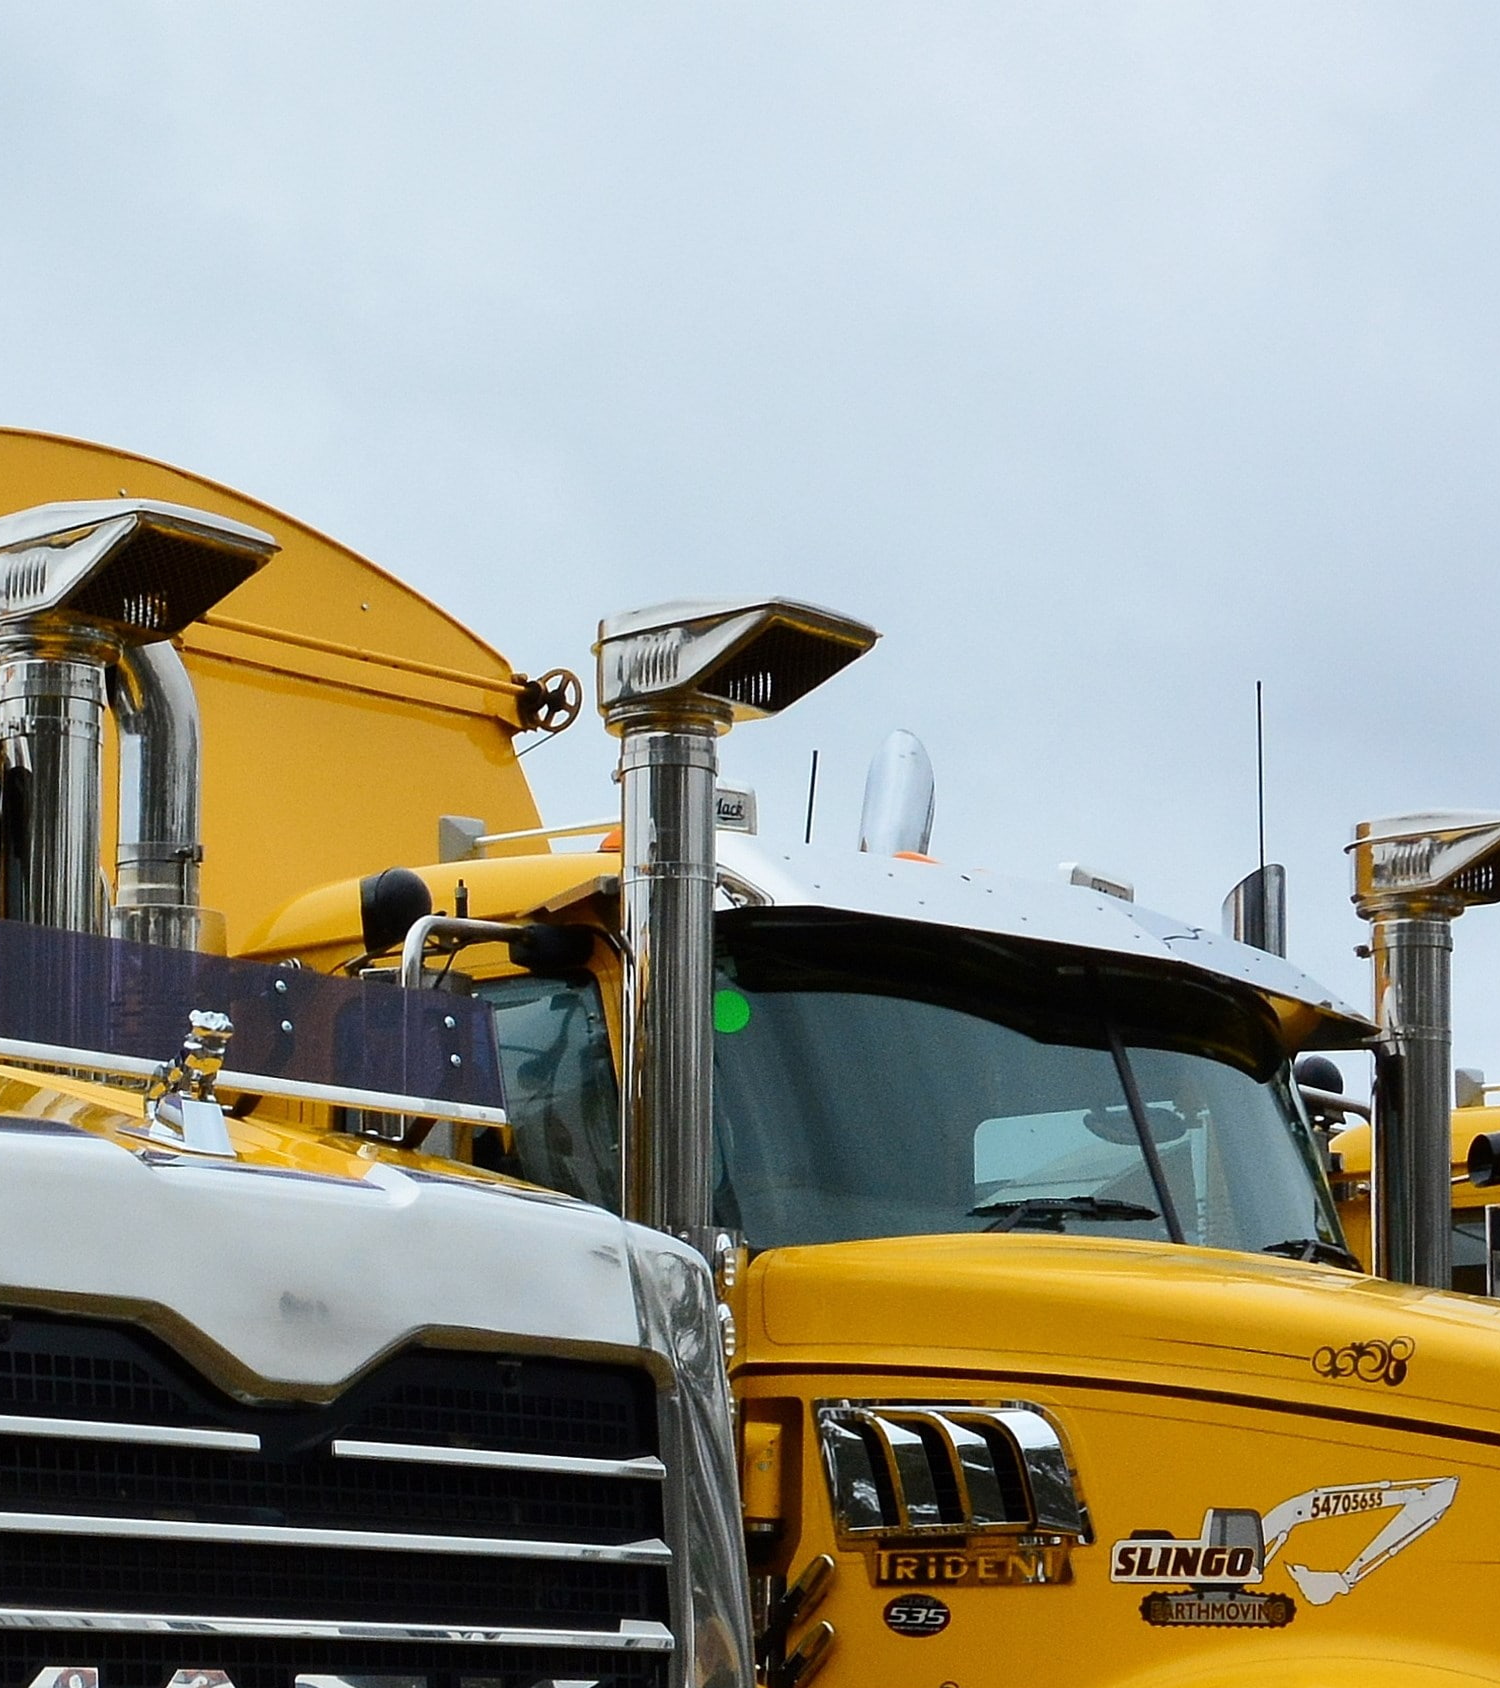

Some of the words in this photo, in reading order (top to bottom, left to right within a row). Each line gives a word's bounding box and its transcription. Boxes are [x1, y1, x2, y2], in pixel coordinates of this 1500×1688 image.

[1310, 1491, 1383, 1519] 54705655
[1115, 1547, 1255, 1578] SLINGO
[888, 1607, 948, 1625] 535
[1151, 1602, 1286, 1624] EARTHMOVING
